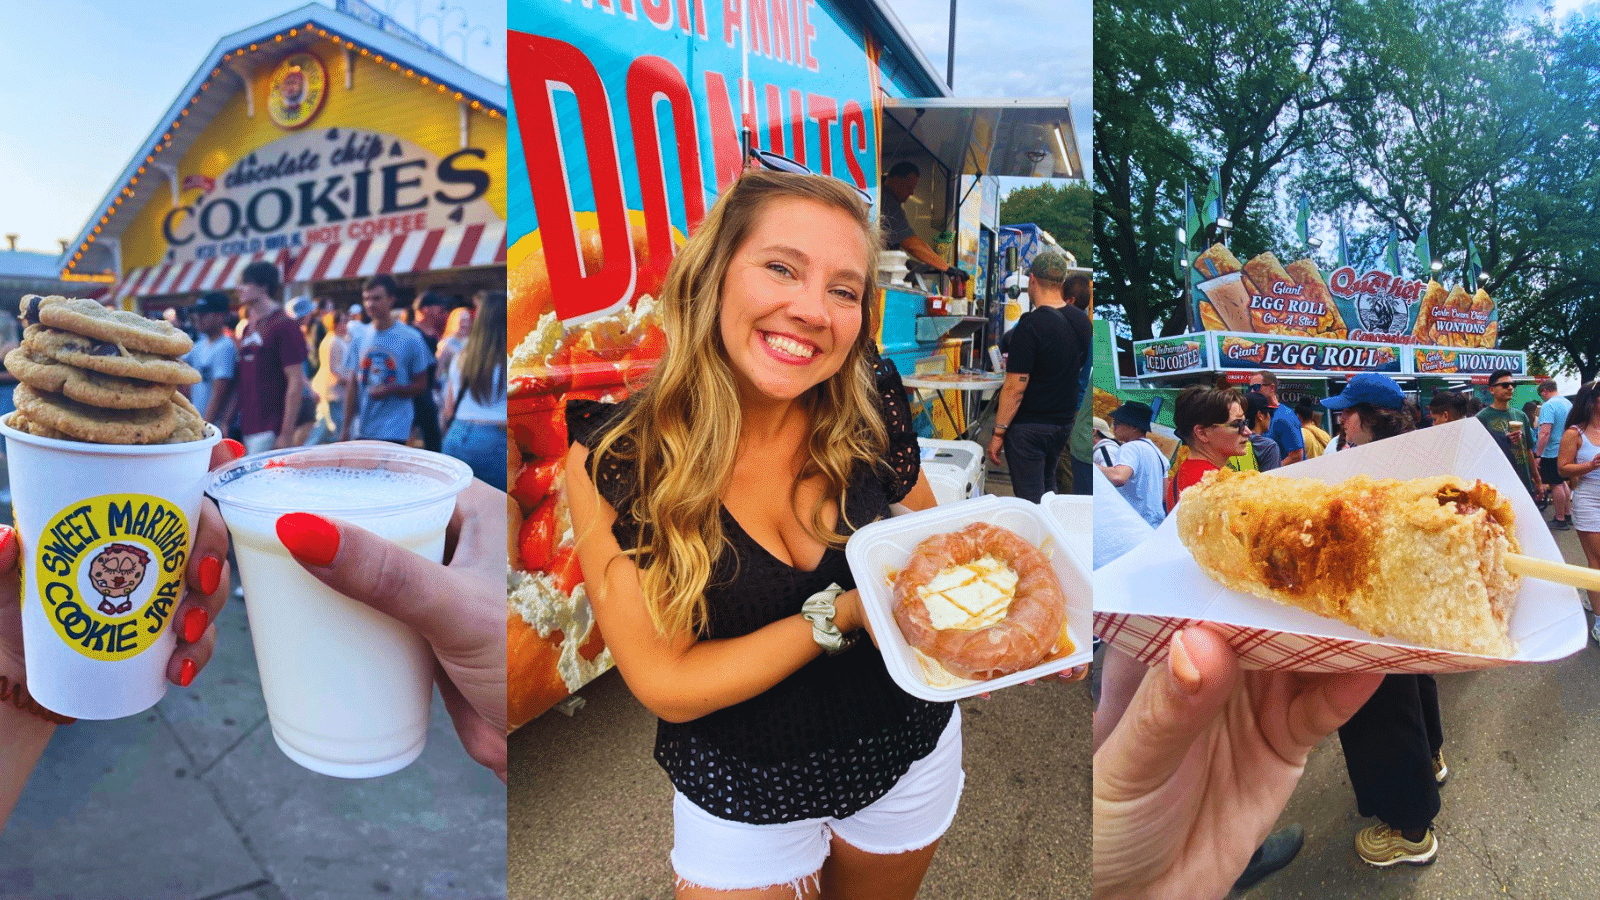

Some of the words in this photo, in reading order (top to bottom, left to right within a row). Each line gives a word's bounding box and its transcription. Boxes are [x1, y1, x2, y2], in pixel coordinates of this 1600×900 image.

[224, 149, 320, 189] chocolate
[330, 132, 383, 169] chip
[162, 147, 490, 246] COOKIES
[305, 225, 341, 245] HOT
[347, 211, 428, 241] COFFEE
[1272, 281, 1303, 295] Giant
[1249, 295, 1284, 311] EGG
[1287, 300, 1327, 316] ROLL
[1436, 320, 1486, 334] WONTONS
[1145, 354, 1165, 370] ICED
[1166, 349, 1199, 370] COFFEE
[1228, 344, 1260, 360] Giant
[1262, 343, 1317, 366] EGG
[1321, 346, 1378, 367] ROLL
[1458, 353, 1520, 371] WONTONS
[42, 505, 101, 577] SWEET
[45, 581, 138, 653] COOKIE
[144, 579, 180, 634] JAR
